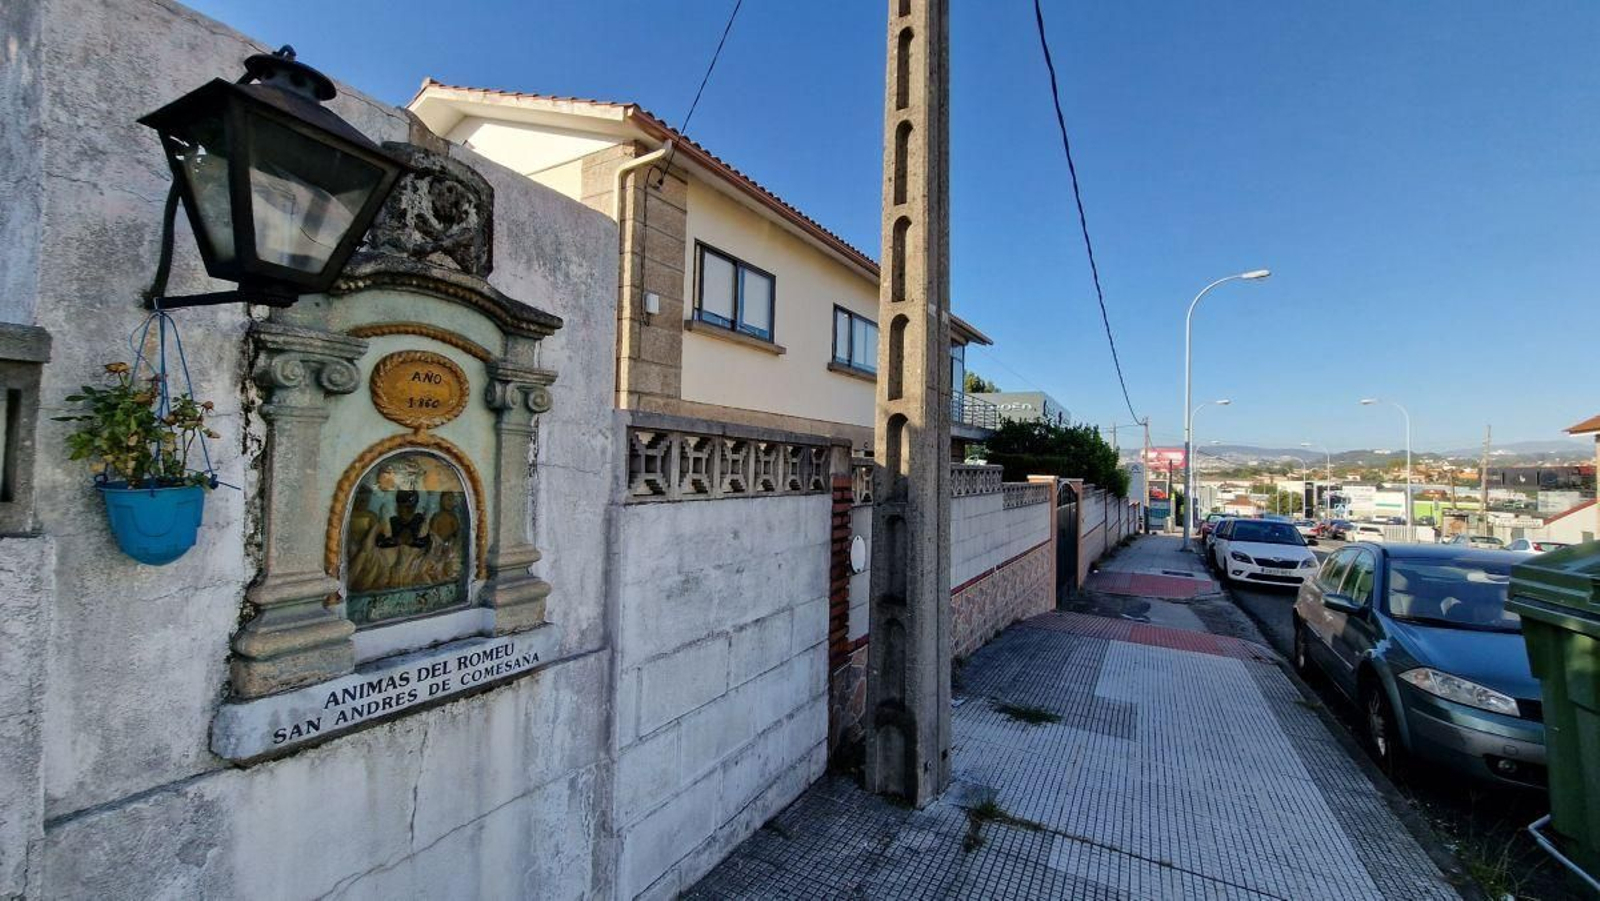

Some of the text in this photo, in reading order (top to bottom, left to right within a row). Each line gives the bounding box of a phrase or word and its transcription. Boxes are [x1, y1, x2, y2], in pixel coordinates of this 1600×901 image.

[411, 370, 442, 384] AÑO
[273, 651, 540, 745] SAN ANDRES DE COMESAÑA
[323, 643, 515, 710] ANIMAS DEL ROMEU
